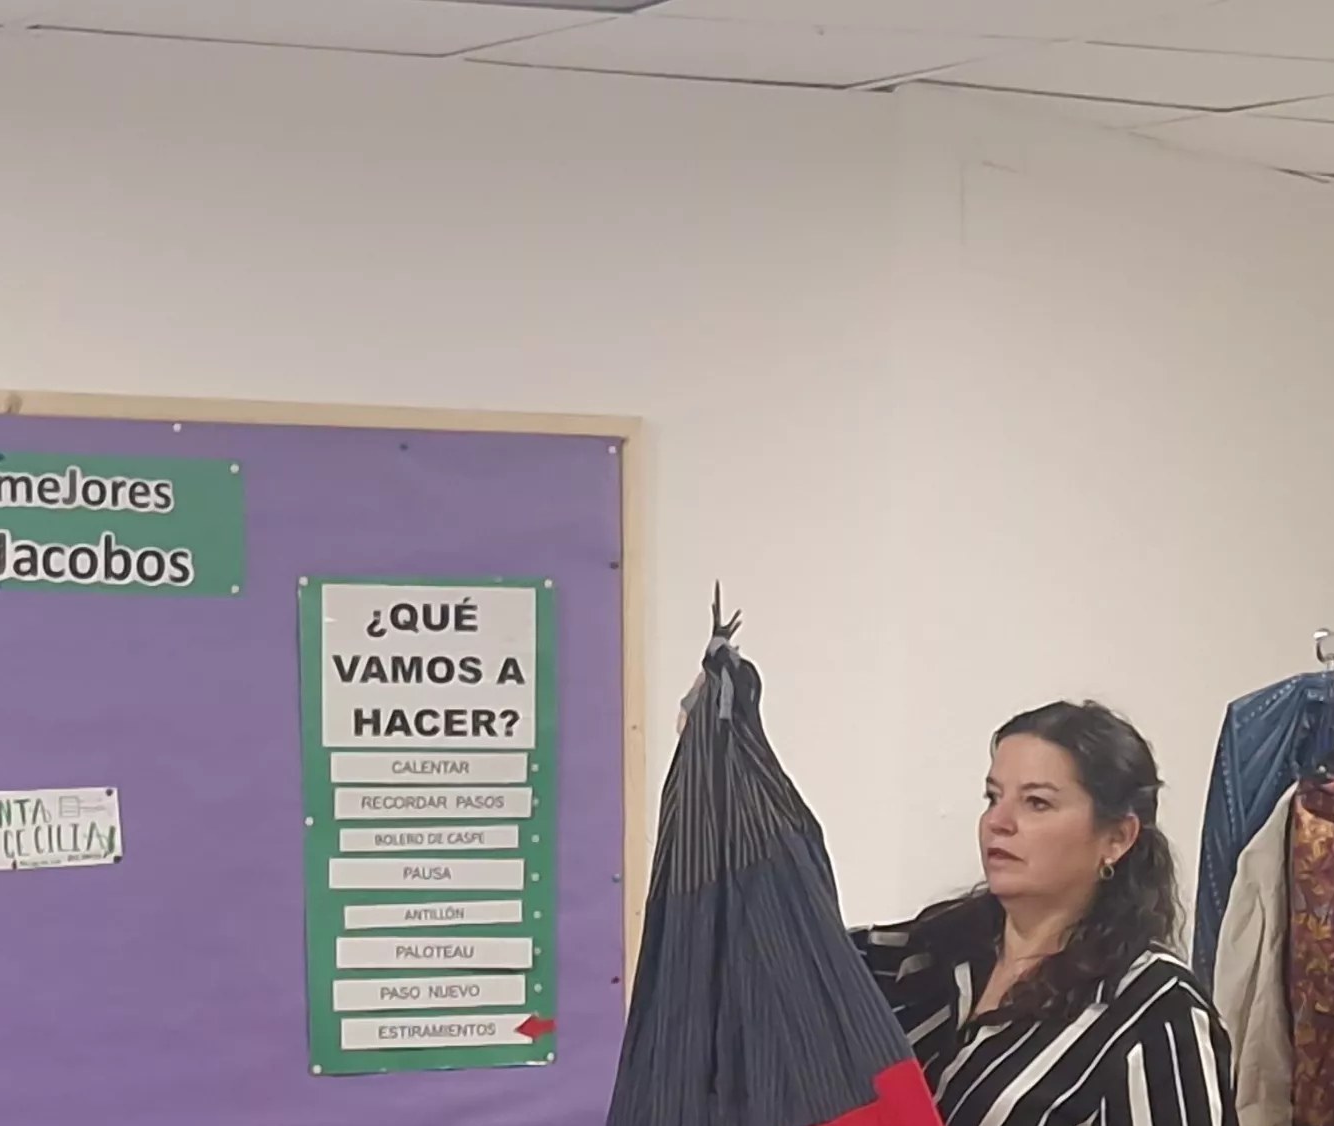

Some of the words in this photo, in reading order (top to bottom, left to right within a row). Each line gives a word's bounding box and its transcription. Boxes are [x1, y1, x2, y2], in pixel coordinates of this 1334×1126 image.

[366, 597, 478, 638] ¿QUÉ
[332, 655, 483, 685] VAMOS
[496, 657, 526, 685] A
[353, 708, 520, 737] HACER?
[391, 760, 470, 775] CALENTAR
[361, 796, 448, 810] RECORDAR
[456, 796, 505, 809] PASOS
[374, 834, 425, 847] BOLERO
[427, 832, 444, 846] DE
[447, 831, 486, 845] CASPE
[402, 866, 452, 880] PAUSA
[404, 906, 465, 922] ANTILLÓN
[395, 945, 475, 960] PALOTEAU
[380, 986, 420, 1000] PASO
[428, 984, 481, 998] NUEVO
[377, 1021, 497, 1040] ESTIRAMIENTOS
